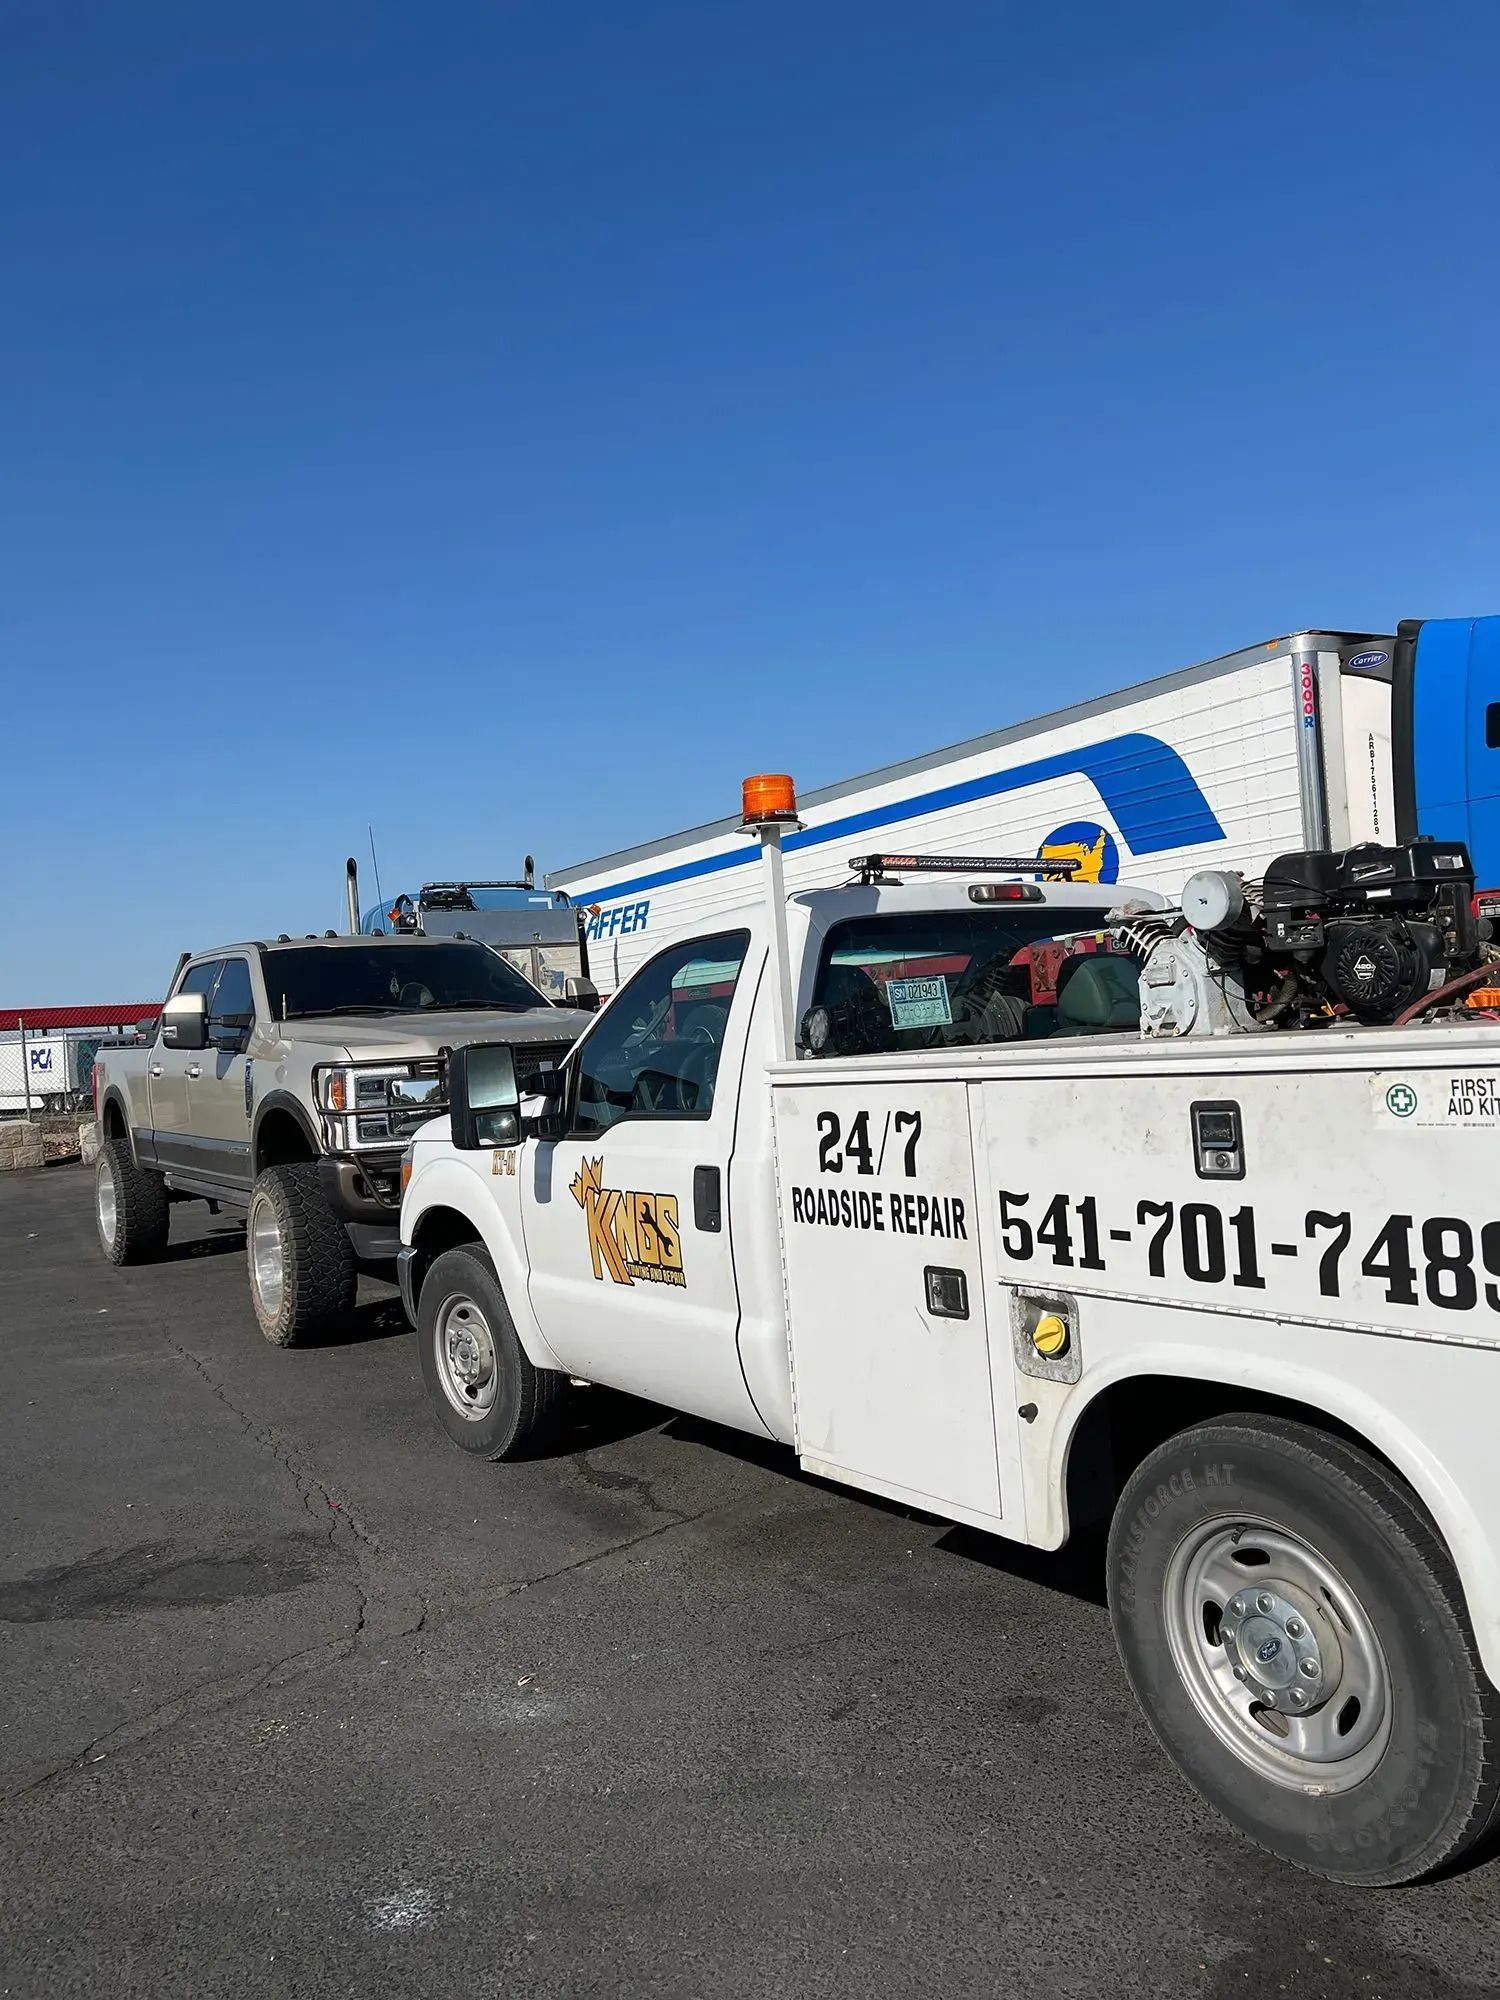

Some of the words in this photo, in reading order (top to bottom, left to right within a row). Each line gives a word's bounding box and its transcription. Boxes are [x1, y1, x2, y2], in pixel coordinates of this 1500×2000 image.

[1353, 653, 1384, 666] Carrier
[1368, 732, 1380, 835] ARB175611289
[895, 987, 906, 999] SN
[908, 982, 938, 999] 021943
[31, 1048, 52, 1070] PCA
[1451, 1078, 1496, 1097] FIRST
[1448, 1098, 1474, 1116] AID
[817, 1110, 922, 1178] 24/7
[791, 1186, 885, 1232] ROADSIDE
[889, 1192, 969, 1241] REPAIR
[1203, 1463, 1235, 1487] HT
